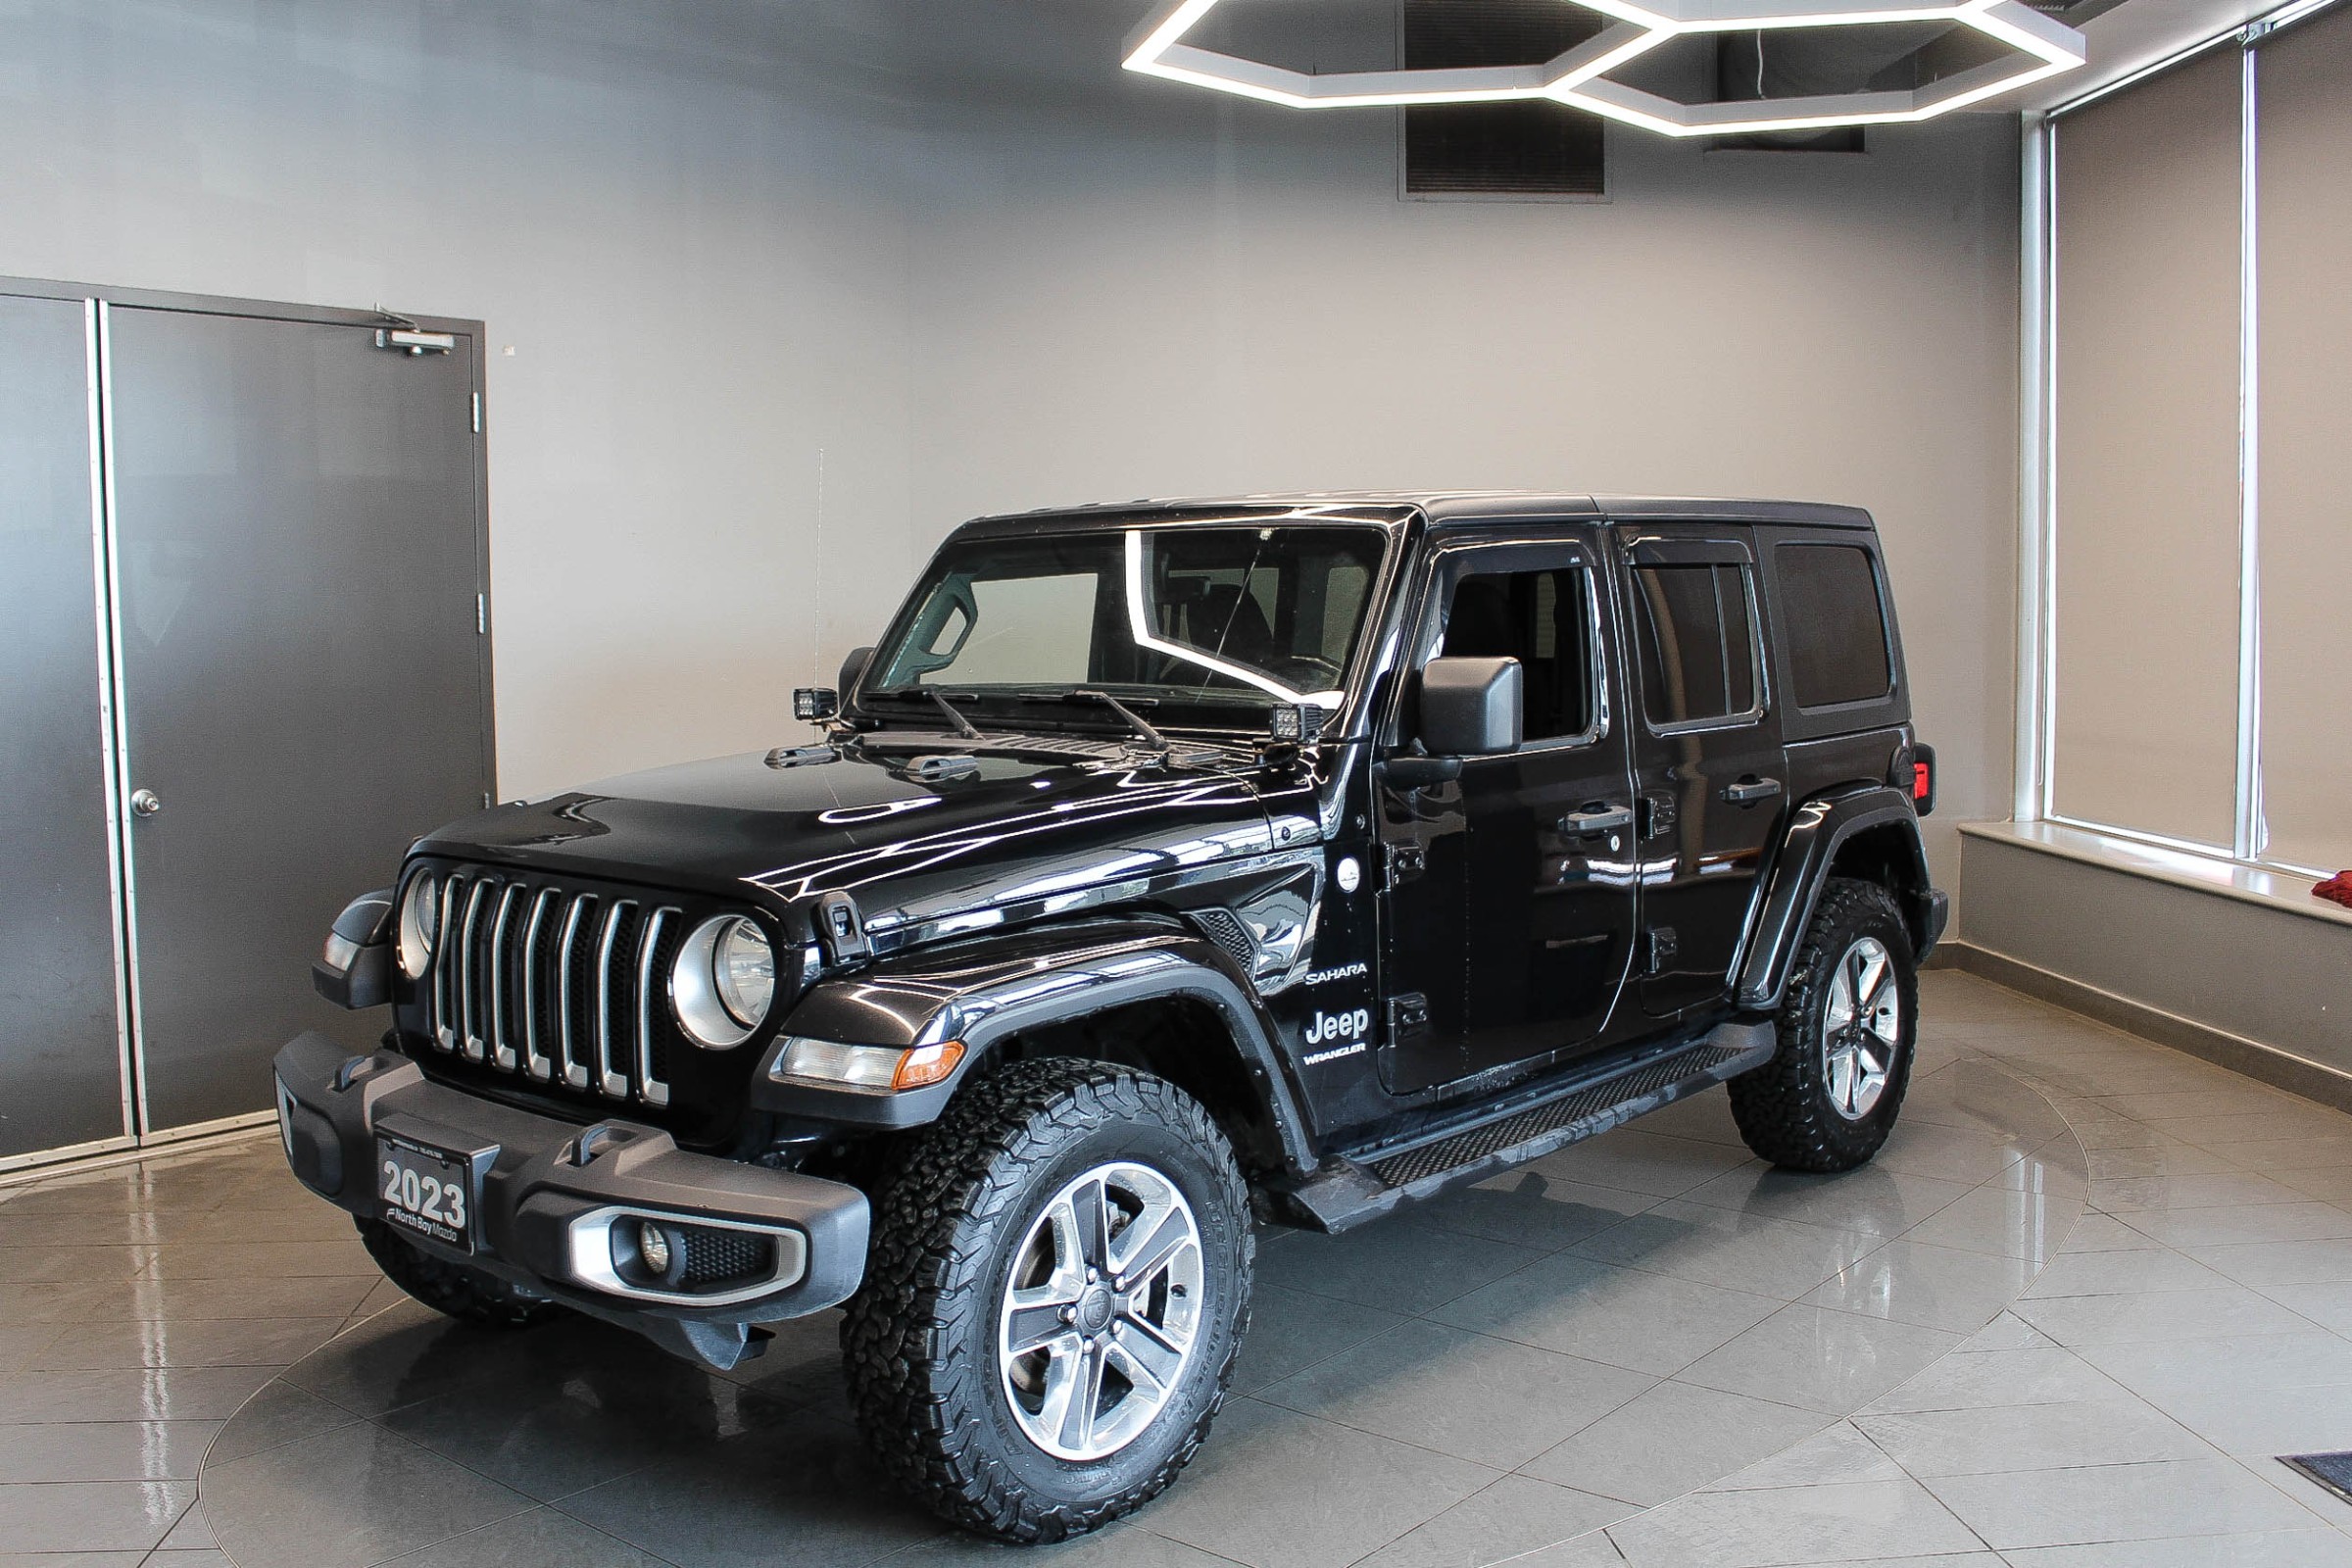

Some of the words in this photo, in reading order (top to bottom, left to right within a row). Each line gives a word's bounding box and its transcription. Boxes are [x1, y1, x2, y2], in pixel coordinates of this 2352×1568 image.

[1305, 962, 1368, 986] SAHARA
[1305, 1008, 1369, 1044] Jeep
[1303, 1042, 1366, 1066] WRANGLER
[383, 1160, 466, 1229] 2023
[395, 1207, 416, 1227] North
[416, 1216, 432, 1235] Bay
